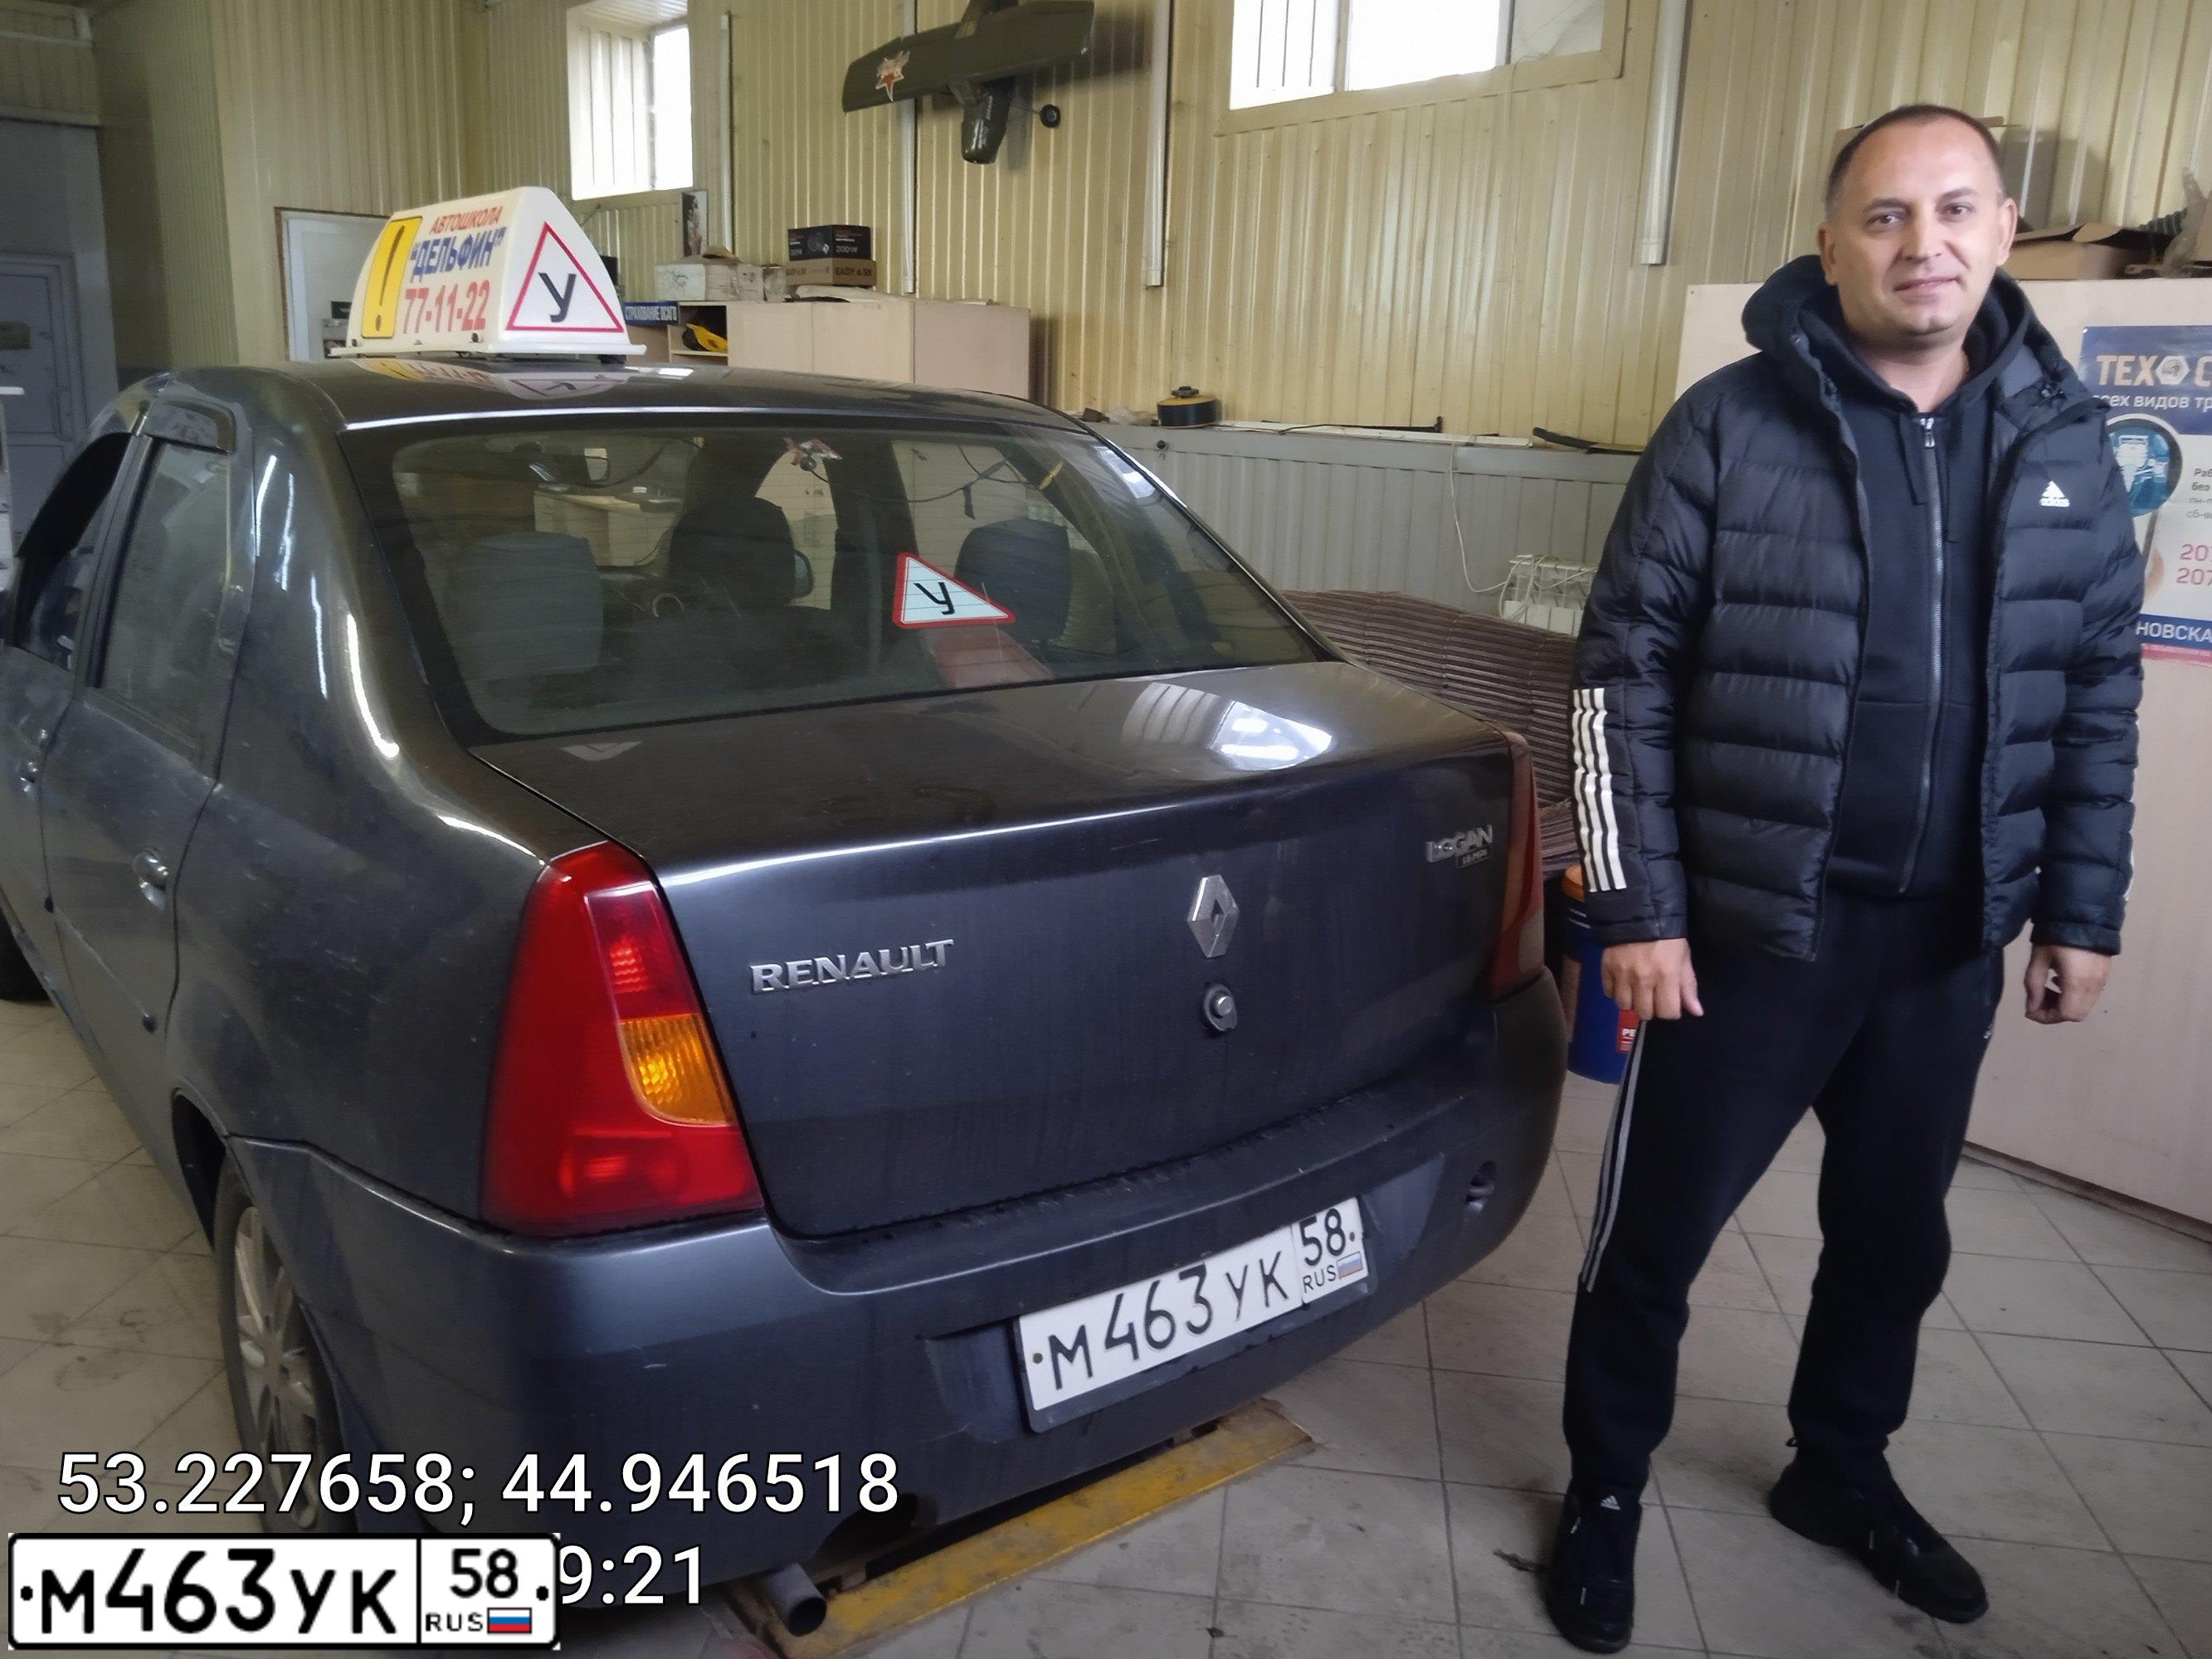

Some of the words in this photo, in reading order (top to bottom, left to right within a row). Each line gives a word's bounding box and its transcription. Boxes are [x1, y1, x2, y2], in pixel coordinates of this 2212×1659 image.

[429, 207, 503, 235] АВТОШКОЛА
[403, 280, 490, 333] 77-11-22
[538, 272, 576, 323] У
[2134, 395, 2190, 410] видов
[2191, 482, 2210, 491] без
[2180, 543, 2212, 562] 20
[914, 582, 956, 615] У
[1425, 824, 1493, 863] LOGAN
[750, 939, 953, 991] RENAULT
[1298, 1208, 1346, 1267] 58
[1303, 1265, 1337, 1293] RUS
[1048, 1251, 1289, 1390] М463УК
